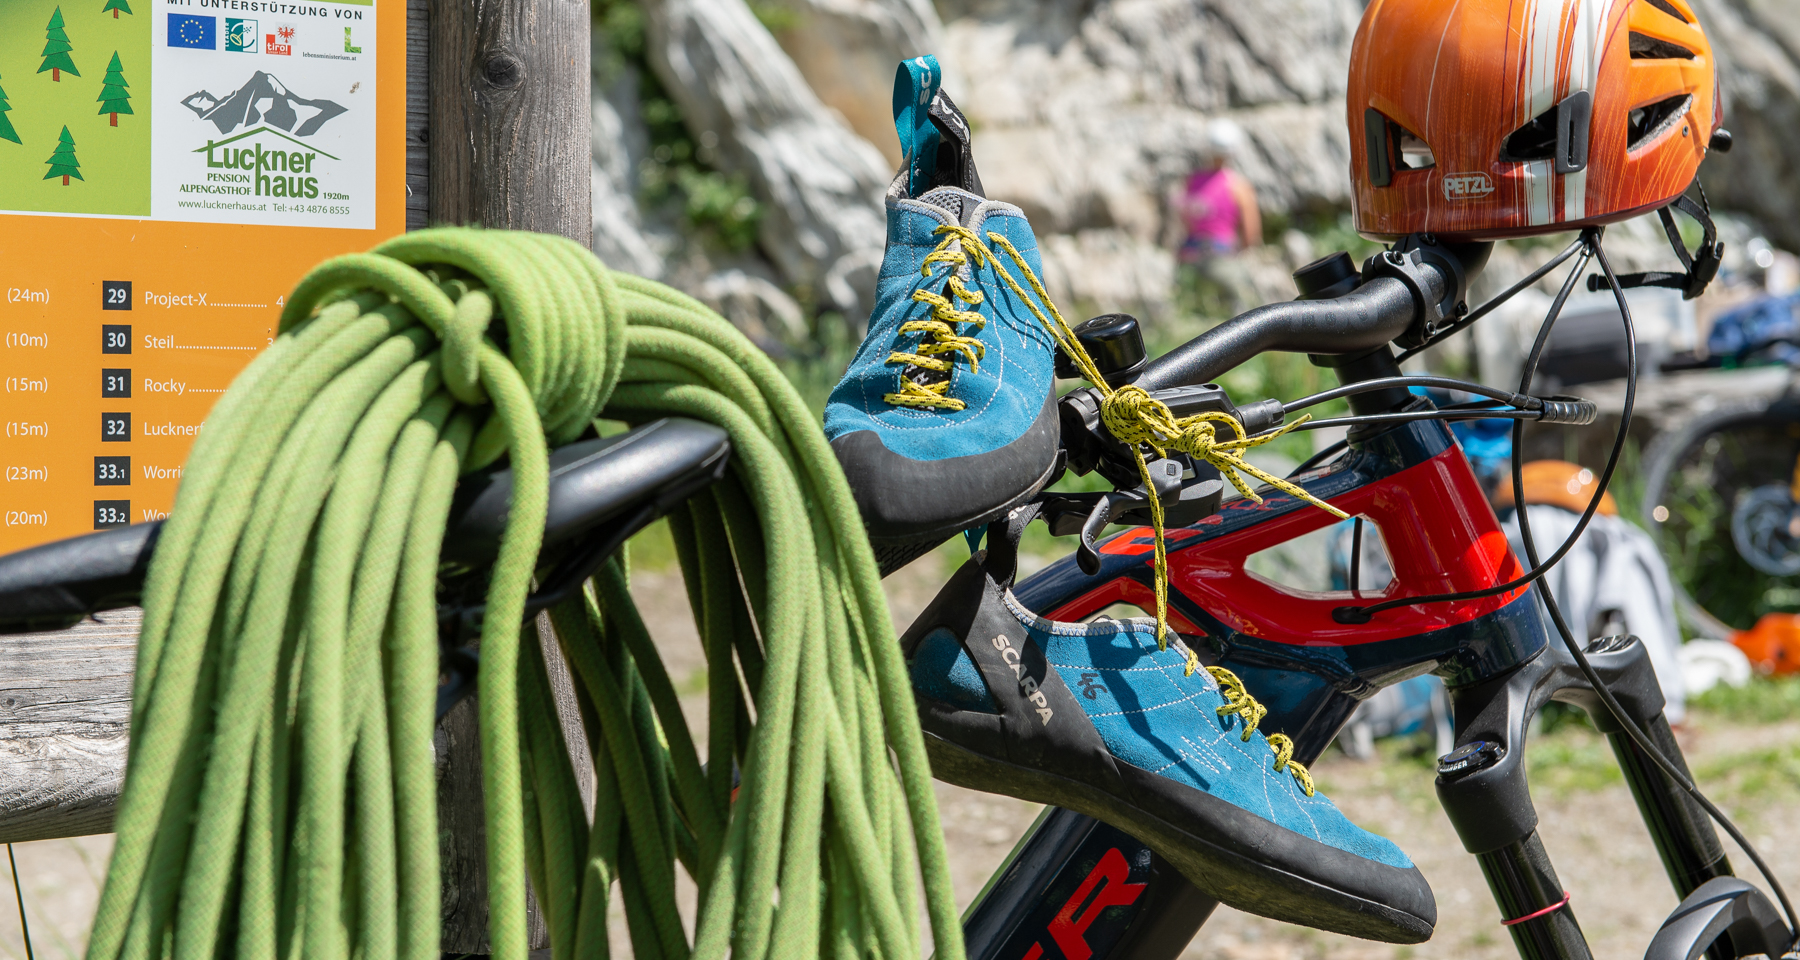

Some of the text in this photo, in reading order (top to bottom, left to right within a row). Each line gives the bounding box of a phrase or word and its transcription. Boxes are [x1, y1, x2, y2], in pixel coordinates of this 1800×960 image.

[200, 0, 328, 17] UNTERSTÜTZUNG
[334, 9, 363, 20] VON
[267, 42, 288, 52] tirol
[302, 51, 357, 62] lebensministerium.at
[207, 139, 316, 174] Luckner
[207, 173, 251, 184] PENSION
[254, 170, 319, 199] haus
[179, 183, 252, 196] ALPENGASTHOF
[322, 192, 350, 201] 1920m
[1444, 176, 1496, 202] PETZL
[178, 200, 350, 215] www.lucknerhaus.at Tel: +43 4876 8555
[7, 287, 50, 304] (24m)
[107, 288, 127, 304] 29
[6, 332, 49, 349] (10m)
[107, 332, 127, 348] 30
[6, 376, 49, 393] (15m)
[107, 376, 126, 392] 31
[6, 420, 49, 438] (15m)
[107, 419, 126, 436] 32
[6, 465, 49, 482] (23m)
[98, 463, 126, 480] 33.1
[5, 509, 48, 527] (20m)
[98, 507, 126, 524] 33.2
[990, 633, 1054, 727] SCARPA
